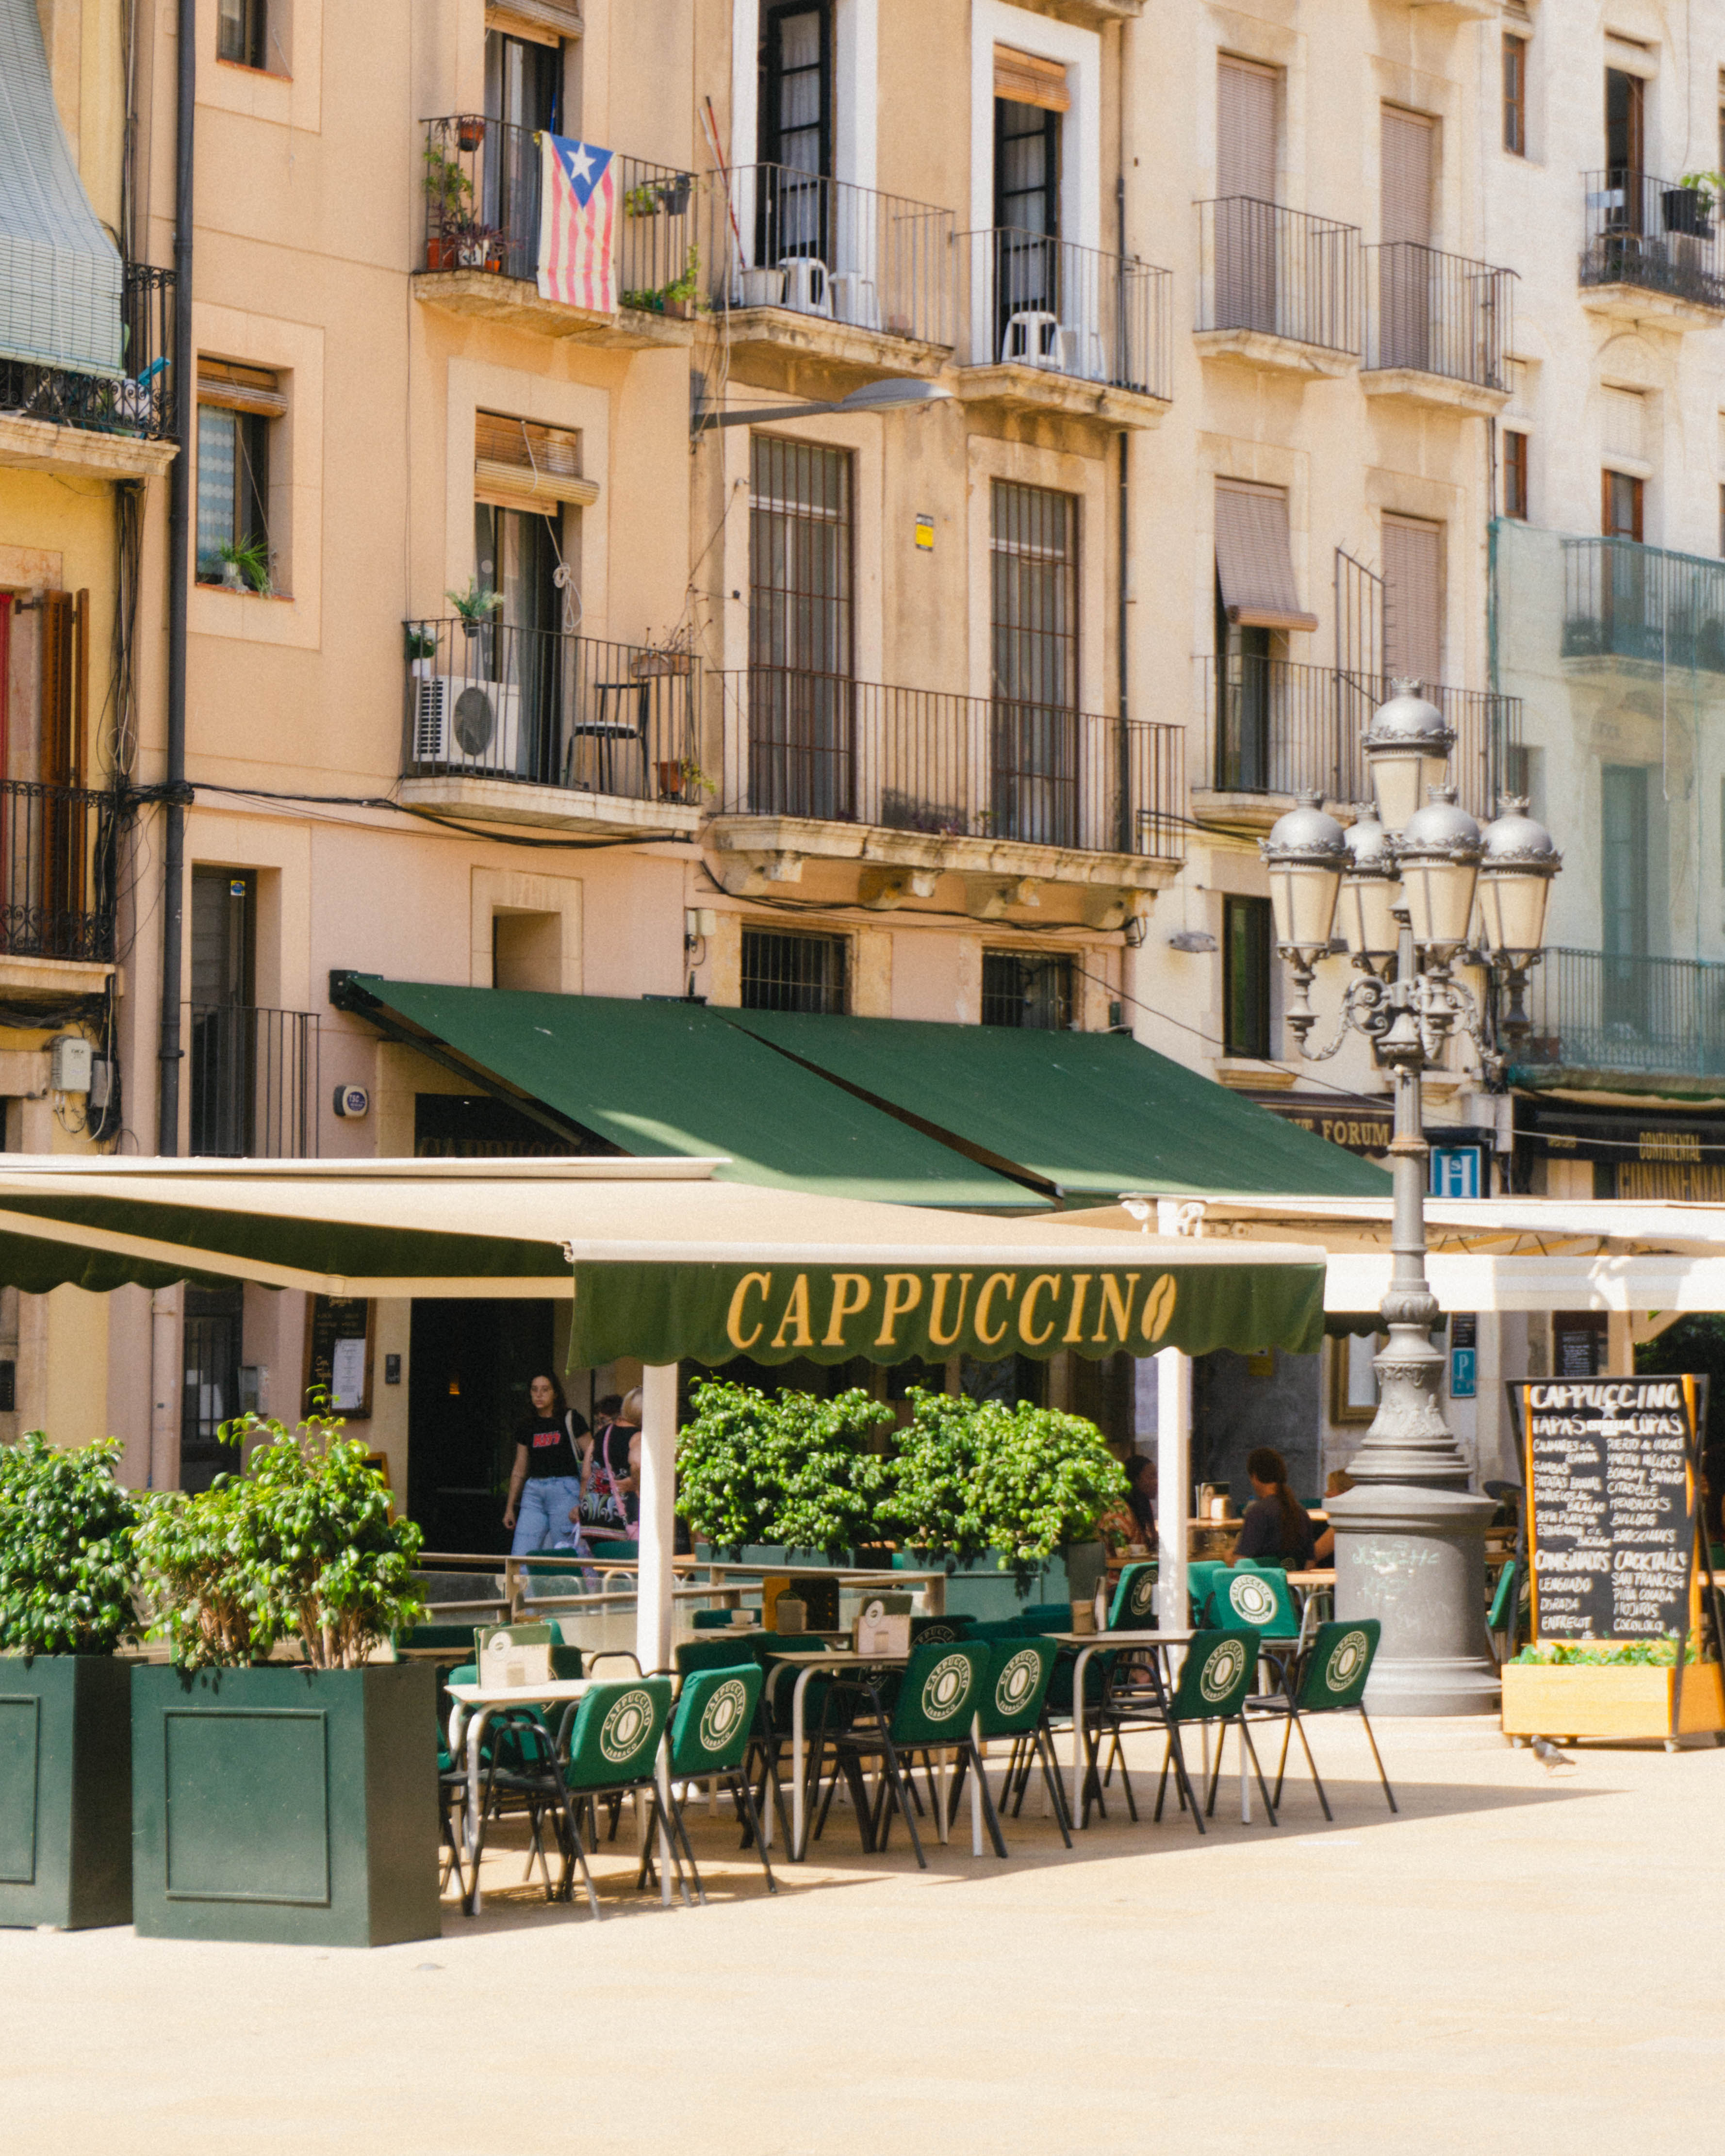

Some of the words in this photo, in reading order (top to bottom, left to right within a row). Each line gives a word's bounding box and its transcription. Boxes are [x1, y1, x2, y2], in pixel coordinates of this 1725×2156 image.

[1321, 1119, 1391, 1146] FORUM
[1639, 1132, 1701, 1162] CONTINENTAL
[1530, 1384, 1682, 1409] CAPPUCCINO
[1532, 1414, 1587, 1436] TAPAS
[1629, 1412, 1685, 1436] COPAS
[1607, 1481, 1658, 1497] CITADELLE
[1539, 1576, 1593, 1593] LENGUADO
[926, 1657, 968, 1690] CAPPUCCINO
[1000, 1652, 1038, 1684] CAPPUCCINO
[605, 1694, 651, 1730] CAPPUCCINO
[705, 1683, 743, 1719] CAPPUCCINO
[927, 1704, 955, 1717] TARRACO
[606, 1743, 637, 1758] TARRACO
[704, 1731, 730, 1747] TARRACO
